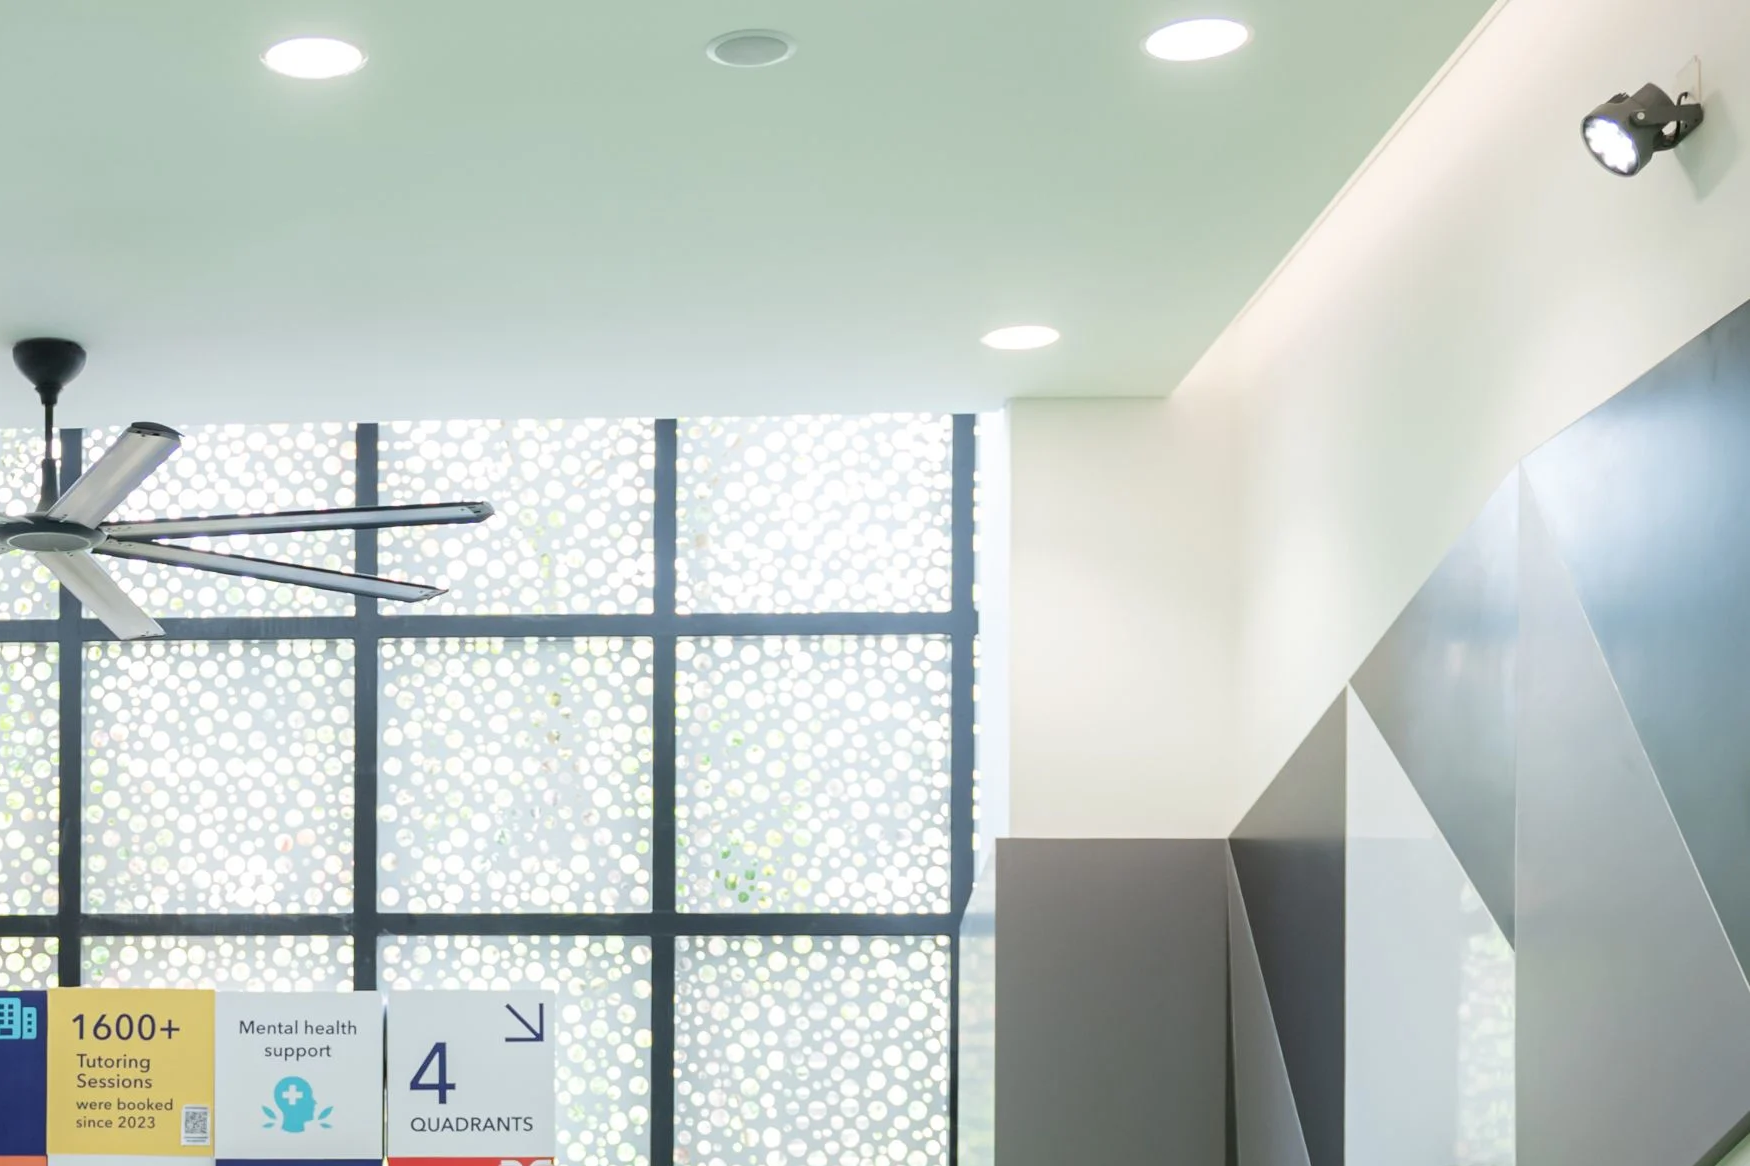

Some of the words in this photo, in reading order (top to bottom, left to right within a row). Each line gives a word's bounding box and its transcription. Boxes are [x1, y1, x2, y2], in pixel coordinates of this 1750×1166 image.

[72, 1013, 180, 1041] 1600+
[239, 1020, 298, 1035] Mental
[304, 1020, 357, 1035] health
[264, 1045, 331, 1061] support
[76, 1053, 150, 1073] Tutoring
[76, 1073, 153, 1089] Sessions
[410, 1042, 456, 1104] 4
[76, 1101, 112, 1110] were
[117, 1098, 174, 1111] booked
[76, 1116, 113, 1128] since
[118, 1116, 156, 1129] 2023
[410, 1117, 534, 1132] QUADRANTS
